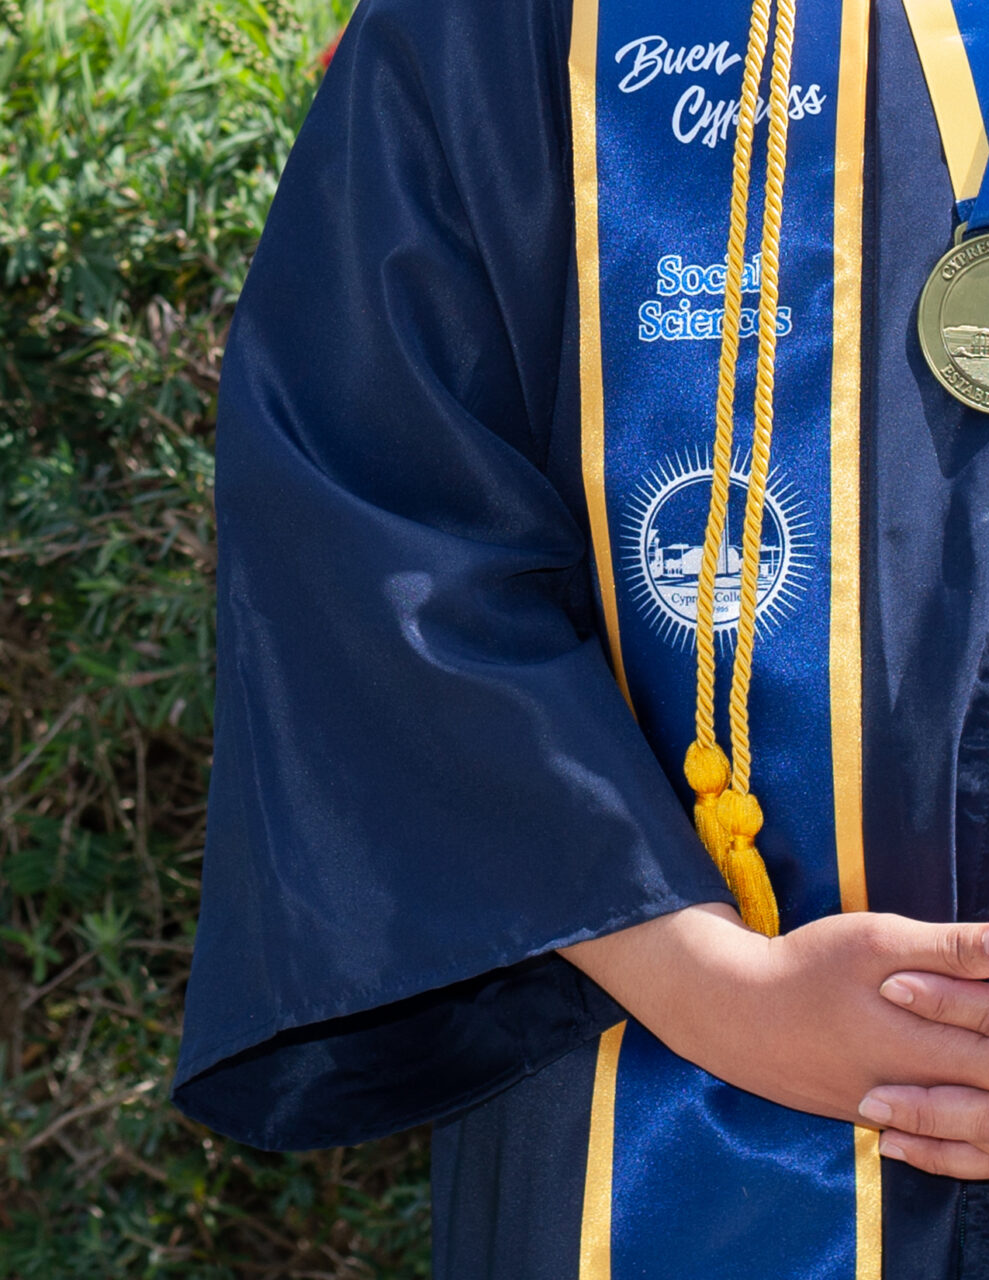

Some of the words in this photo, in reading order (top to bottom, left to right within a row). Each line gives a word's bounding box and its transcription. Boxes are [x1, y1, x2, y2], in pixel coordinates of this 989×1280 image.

[614, 34, 742, 94] Buen
[671, 83, 828, 149] Cyprss
[656, 252, 763, 296] Socal
[671, 592, 699, 606] Cypr
